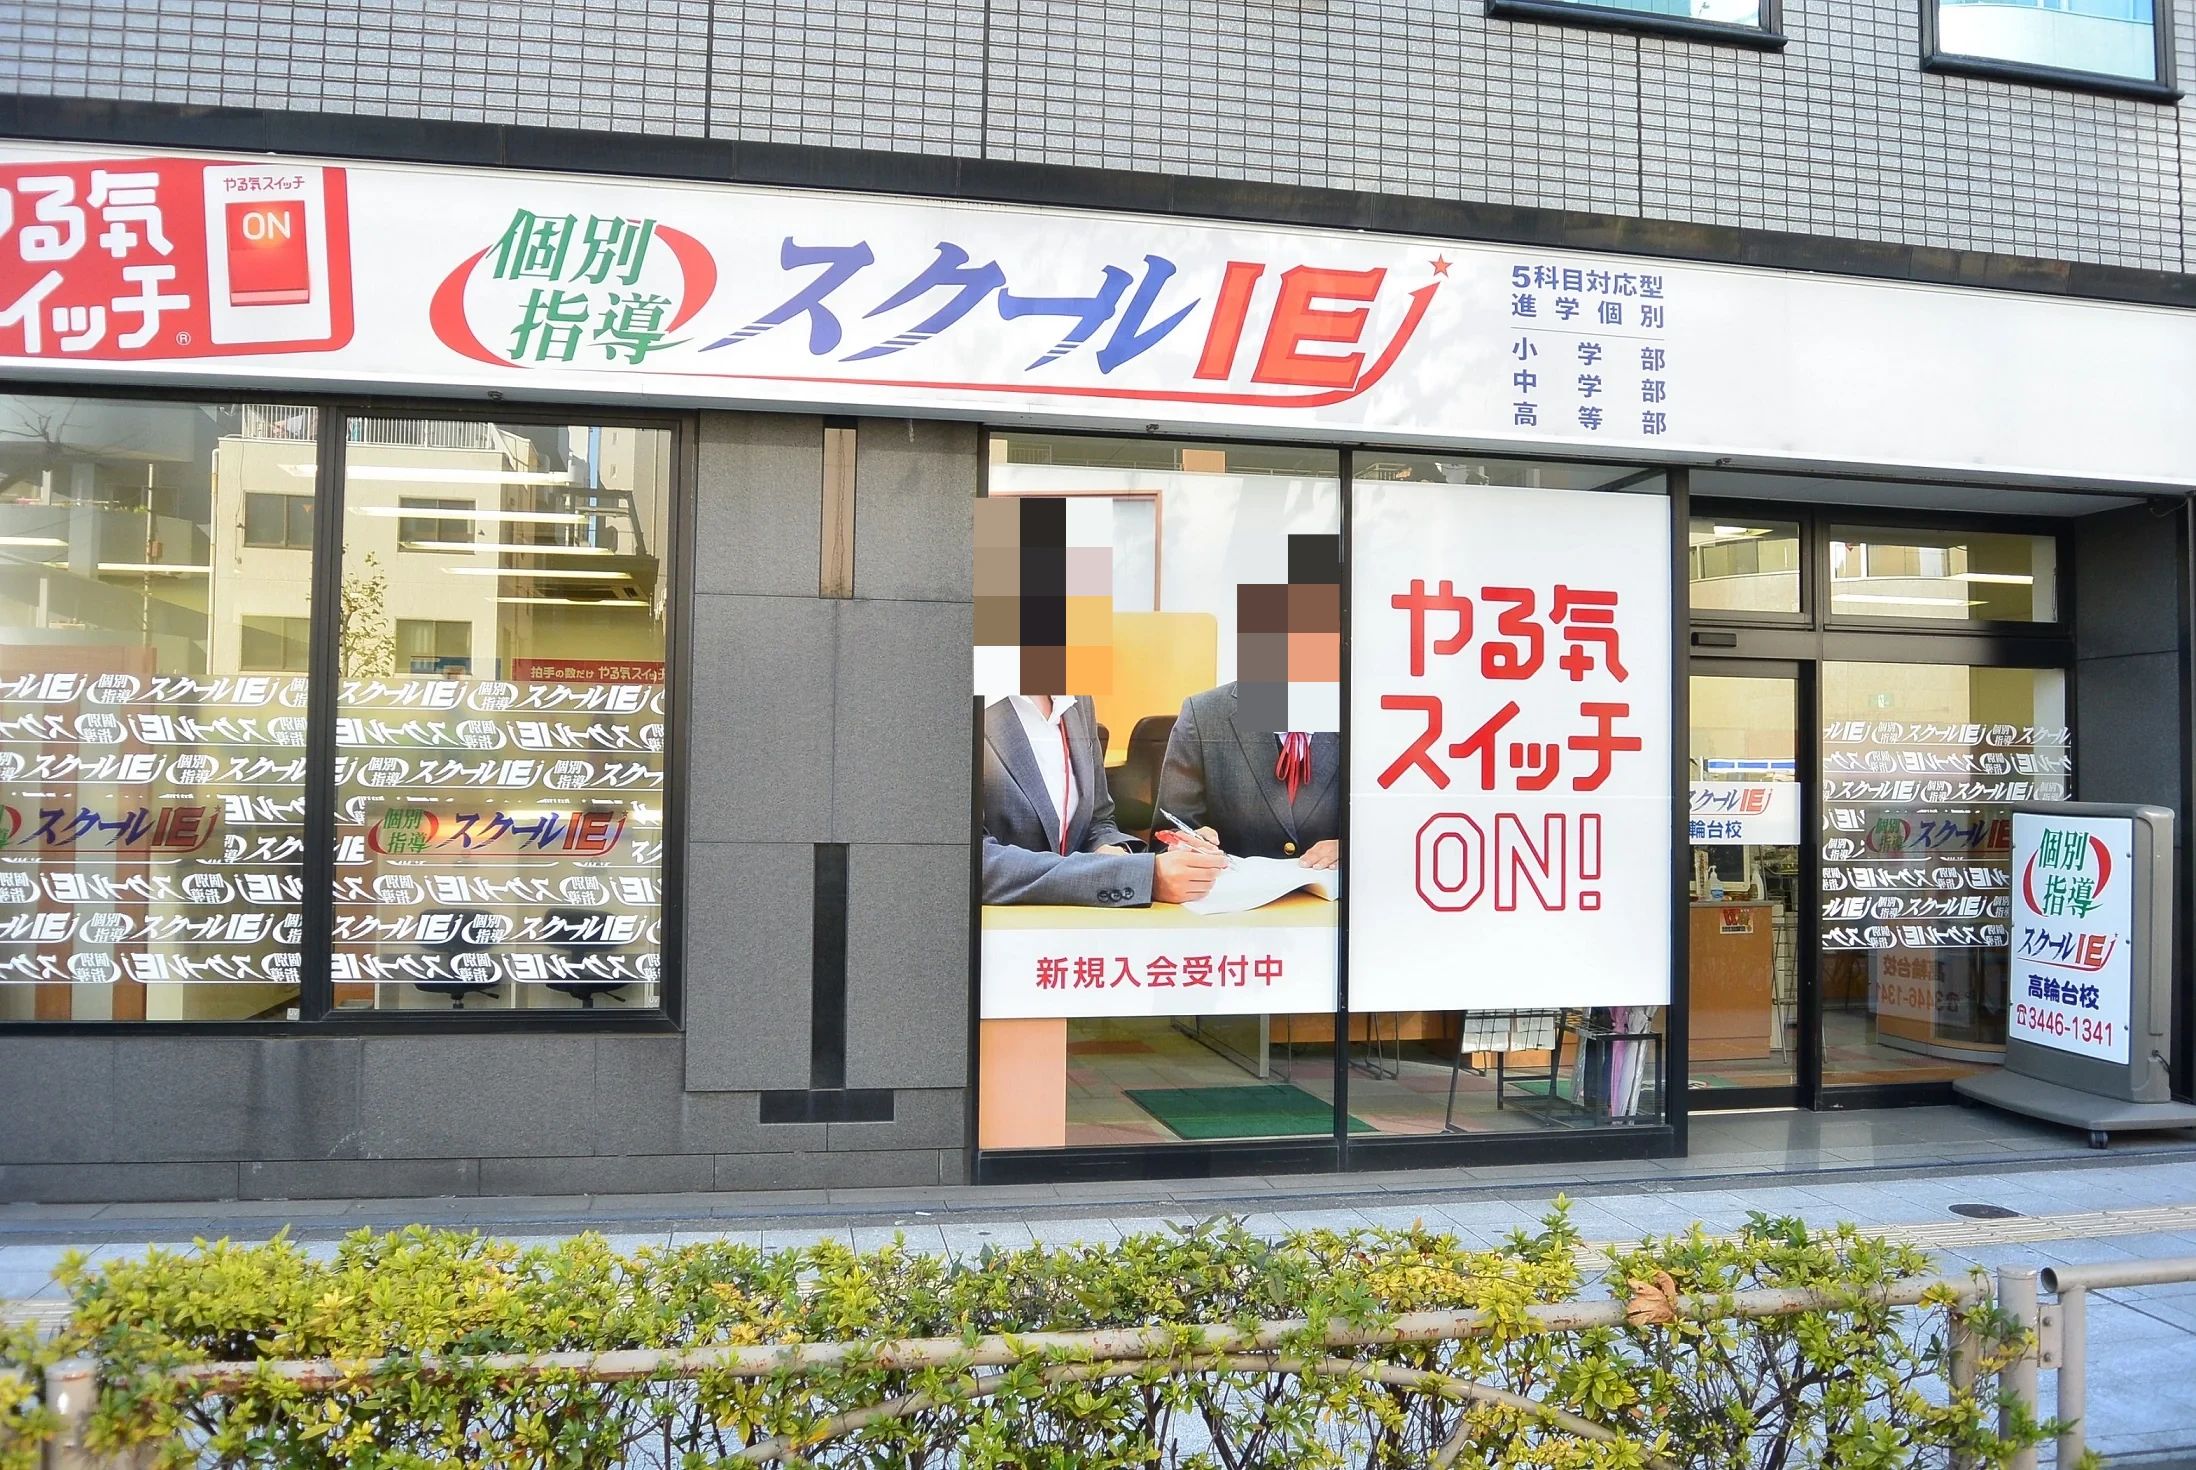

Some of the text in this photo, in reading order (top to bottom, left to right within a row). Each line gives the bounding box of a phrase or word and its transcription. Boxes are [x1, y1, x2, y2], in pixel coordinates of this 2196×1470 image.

[224, 176, 305, 191] やる気スイッチ
[0, 170, 174, 262] る気
[242, 211, 290, 240] ON
[486, 207, 657, 285] 個別
[1512, 265, 1664, 299] 5科目対応型
[0, 265, 190, 353] イッチ
[507, 288, 695, 364] 指導
[1512, 293, 1664, 329] 進学個別
[1512, 337, 1666, 371] 小学部
[1513, 369, 1666, 403] 中学部
[1513, 401, 1667, 435] 高等部
[1390, 579, 1629, 682] やる気
[1377, 694, 1642, 790] スイッチ
[384, 808, 422, 829] 個別
[388, 831, 431, 854] 指導
[2038, 827, 2089, 870] 個別
[1415, 813, 1602, 911] ON!
[2042, 874, 2103, 919] 指導
[1036, 954, 1284, 989] 新規入会受付中
[2028, 974, 2099, 1010] 高輪台校
[2029, 1007, 2113, 1047] 3446-1341
